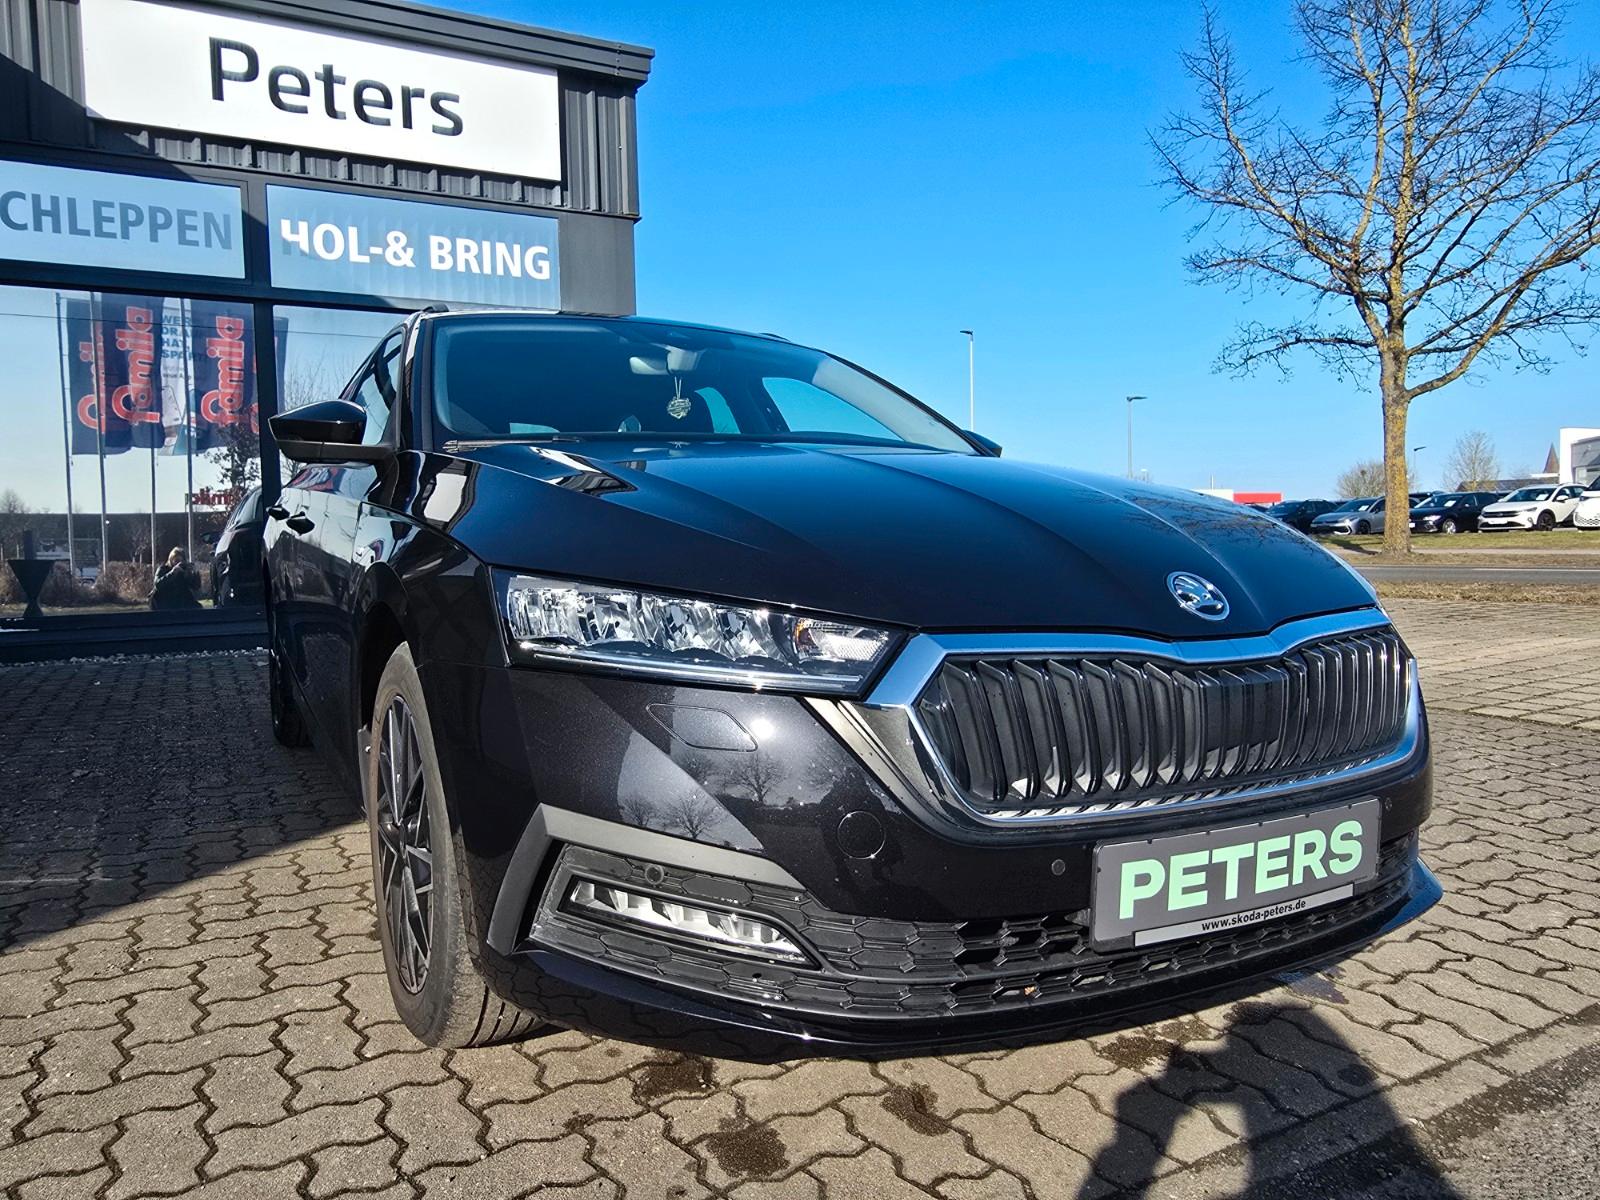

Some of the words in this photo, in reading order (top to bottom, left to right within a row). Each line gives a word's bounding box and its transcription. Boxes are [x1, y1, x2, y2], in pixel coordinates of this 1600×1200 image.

[208, 36, 464, 137] Peters
[0, 190, 233, 250] CHLEPPEN
[429, 235, 551, 281] BRING
[110, 306, 160, 425] famila
[200, 315, 246, 428] famila
[1119, 820, 1363, 919] PETERS
[1201, 899, 1306, 931] www.skoda-peters.de
